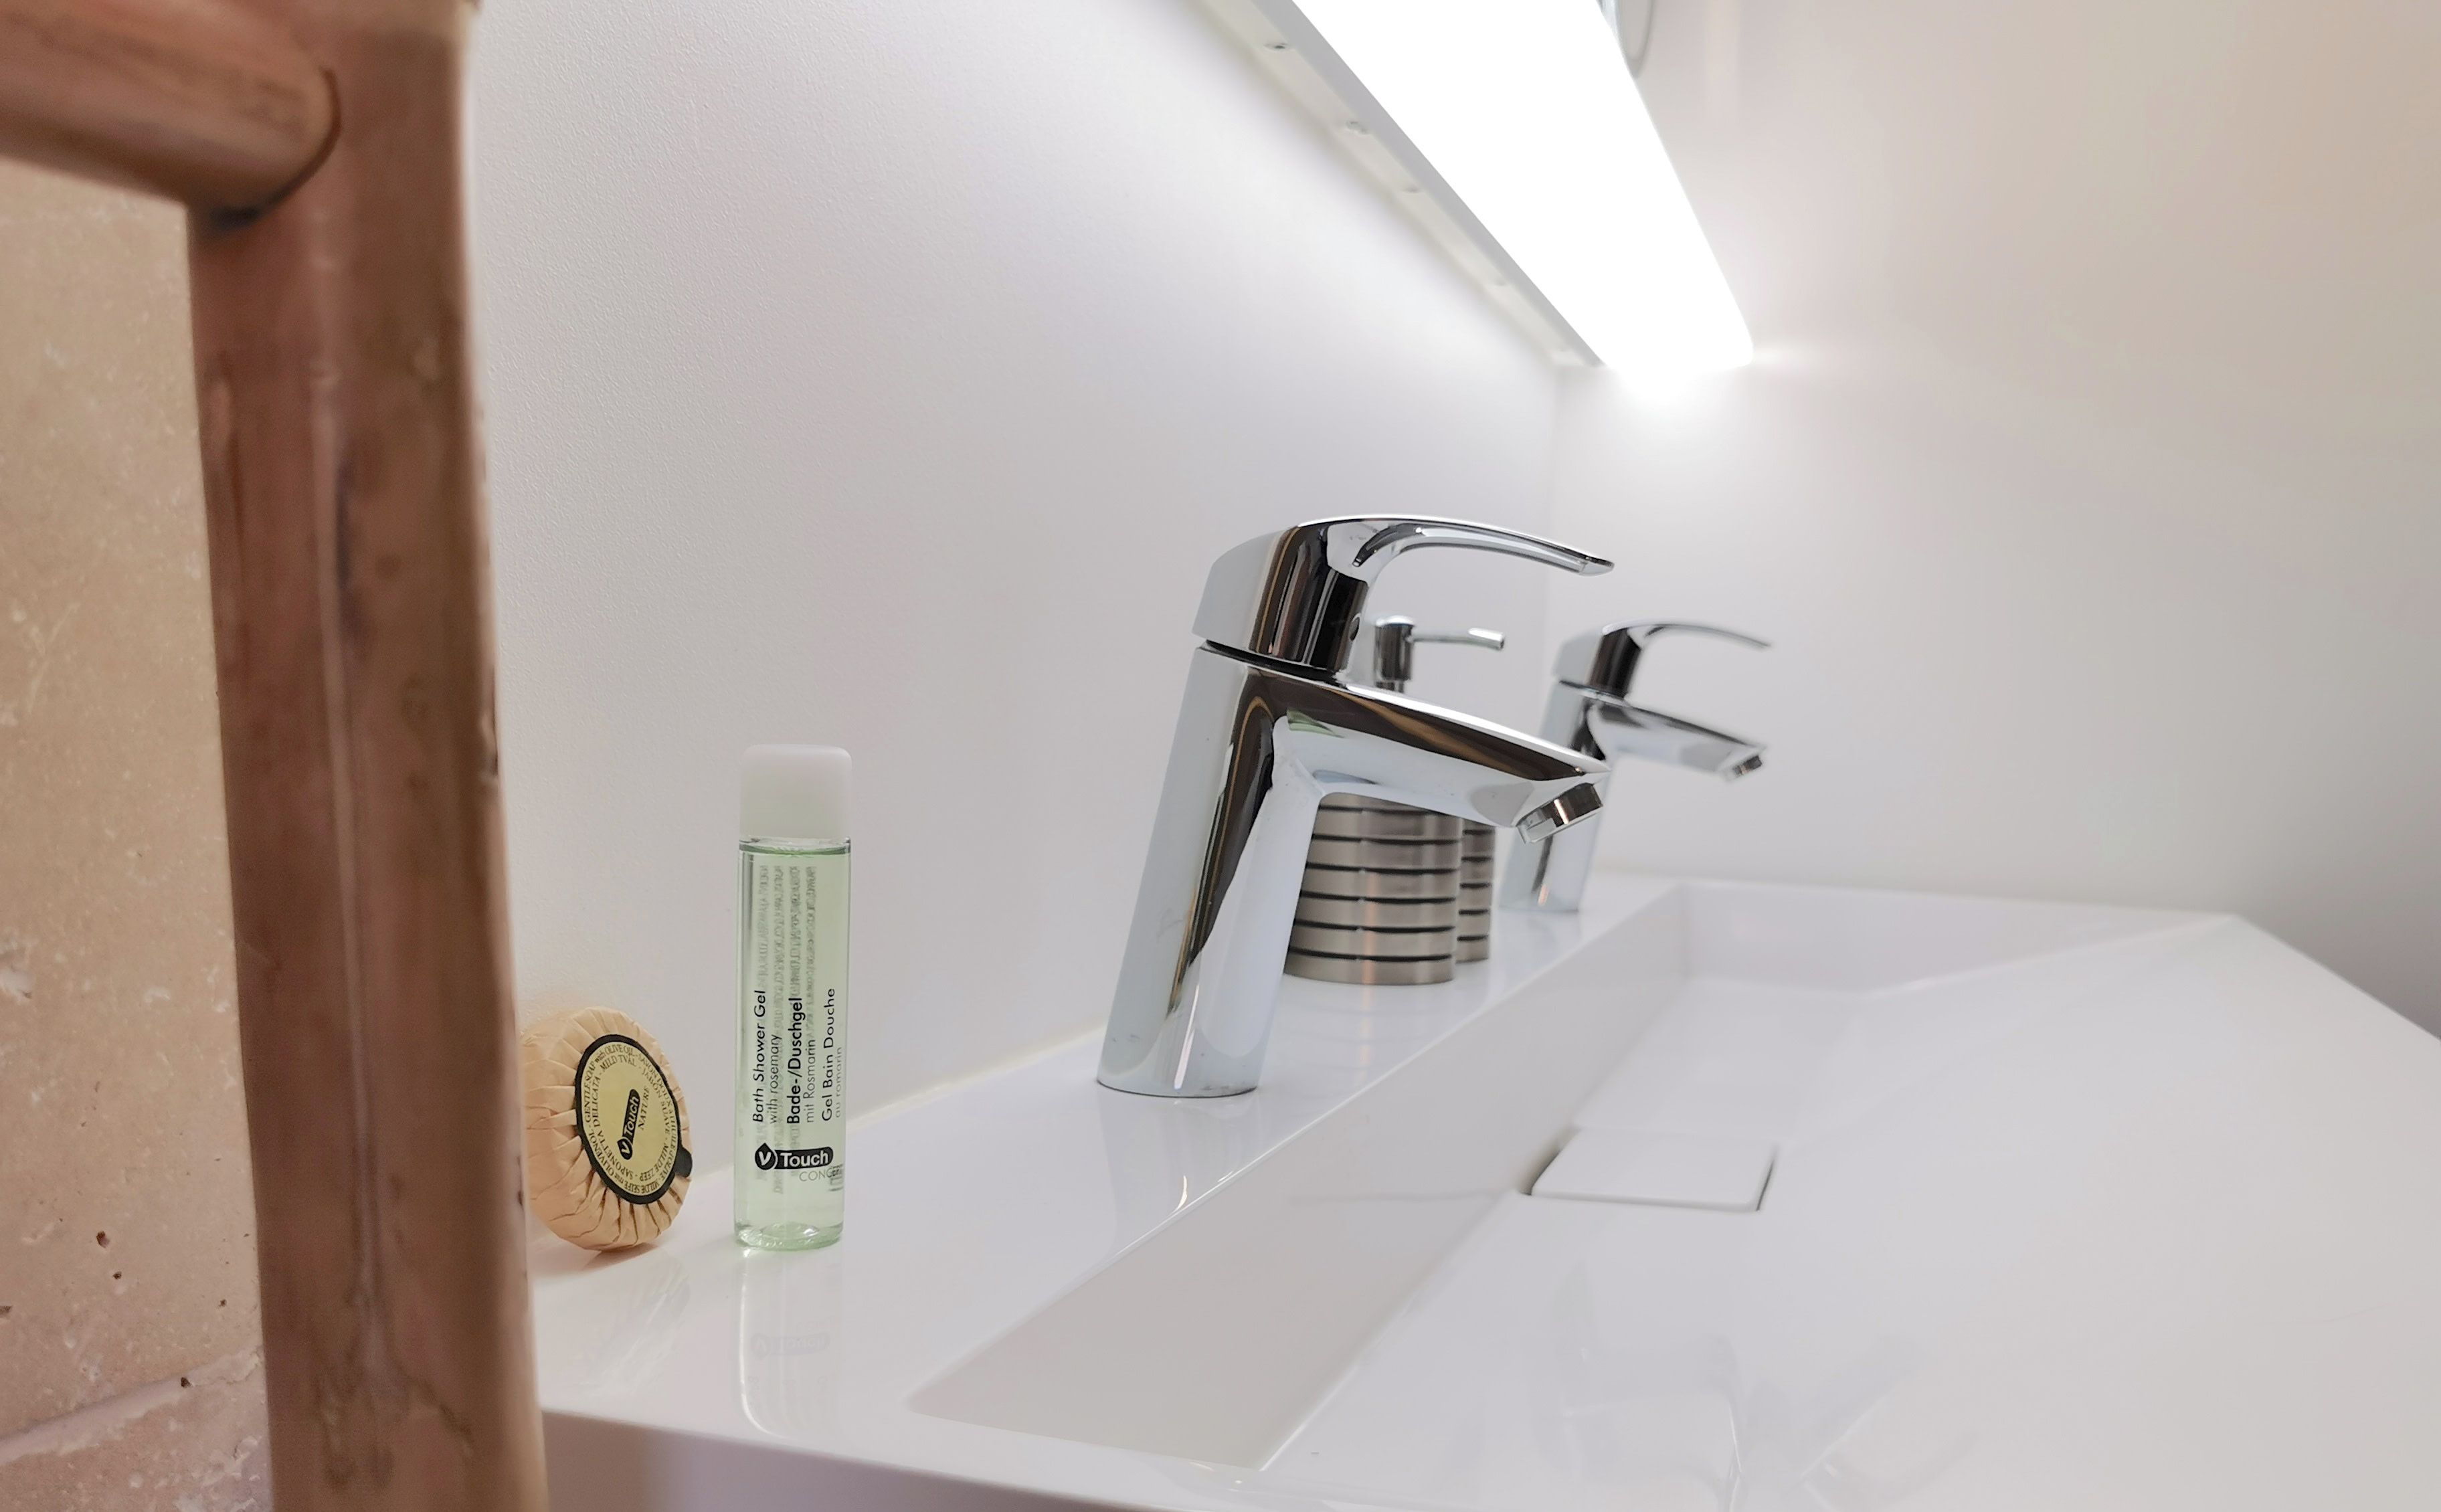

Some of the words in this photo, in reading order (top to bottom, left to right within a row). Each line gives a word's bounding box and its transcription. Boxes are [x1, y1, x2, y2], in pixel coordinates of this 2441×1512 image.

[754, 990, 765, 1017] Gel
[824, 988, 835, 1048] Douche
[600, 1055, 618, 1072] MILD
[604, 1044, 623, 1055] OLIVE
[753, 1024, 765, 1082] Shower
[770, 1034, 782, 1094] rosemary
[787, 998, 806, 1123] Bade-/Duschgel
[584, 1059, 596, 1084] SOAP
[803, 1040, 816, 1099] Rosmarin
[823, 1054, 833, 1089] Bain
[583, 1081, 592, 1122] GENTLE
[590, 1072, 600, 1127] DELICATA
[624, 1097, 640, 1136] Touch
[638, 1086, 650, 1131] NATURE
[753, 1089, 764, 1123] Bath
[765, 1099, 778, 1124] with
[804, 1105, 814, 1123] mit
[822, 1095, 832, 1121] Gel
[836, 1102, 841, 1118] au
[596, 1130, 634, 1180] SAPONETTA
[780, 1150, 828, 1167] Touch
